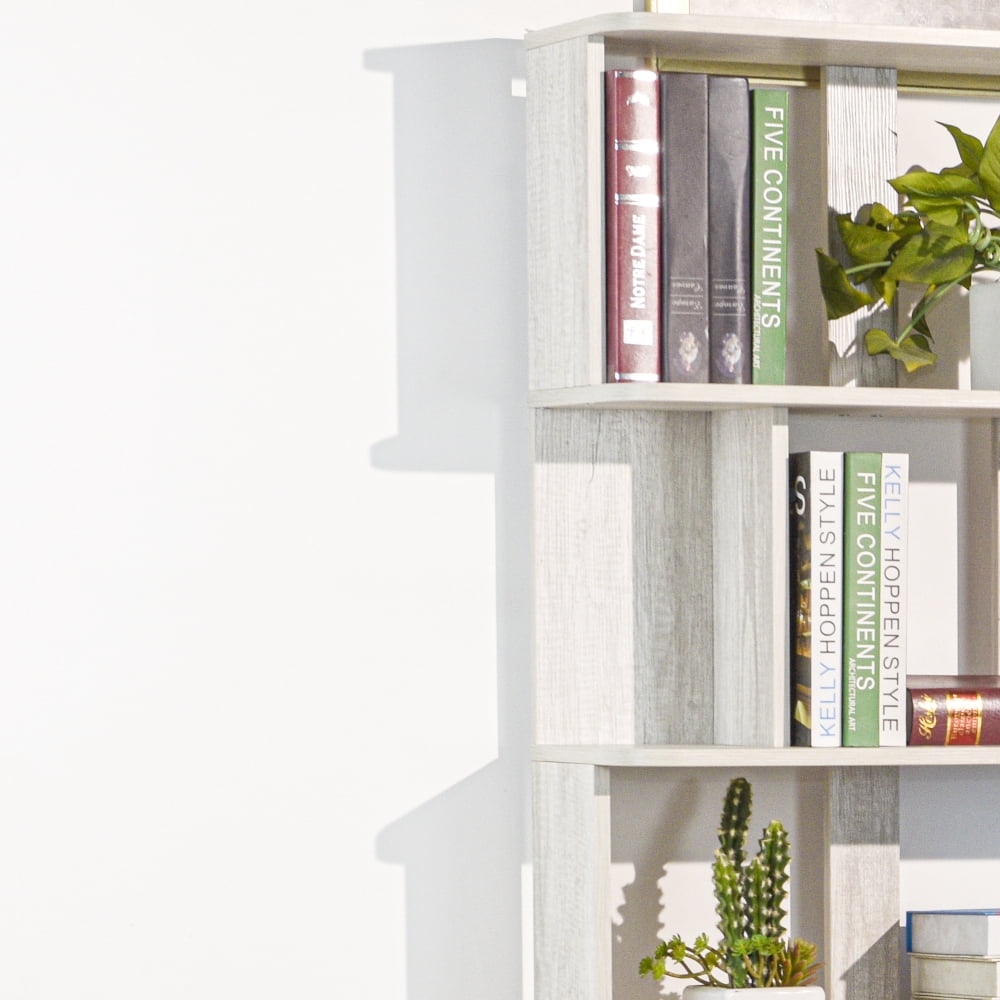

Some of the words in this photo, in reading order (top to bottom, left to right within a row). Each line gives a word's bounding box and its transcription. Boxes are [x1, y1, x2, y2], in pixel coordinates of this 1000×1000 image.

[762, 107, 784, 161] FIVE
[630, 213, 646, 257] DAME
[761, 169, 783, 328] CONTINENTS
[630, 258, 646, 309] NOTRE
[753, 294, 762, 353] ARCHITECTURAL
[752, 354, 761, 369] ART
[819, 468, 836, 545] STYLE
[857, 472, 876, 526] FIVE
[884, 465, 901, 541] KELLY
[819, 553, 836, 654] HOPPEN
[856, 533, 876, 691] CONTINENTS
[883, 548, 901, 648] HOPPEN
[819, 662, 836, 737] KELLY
[848, 657, 857, 715] ARCHITECTURAL
[882, 656, 900, 732] STYLE
[848, 716, 857, 732] ART
